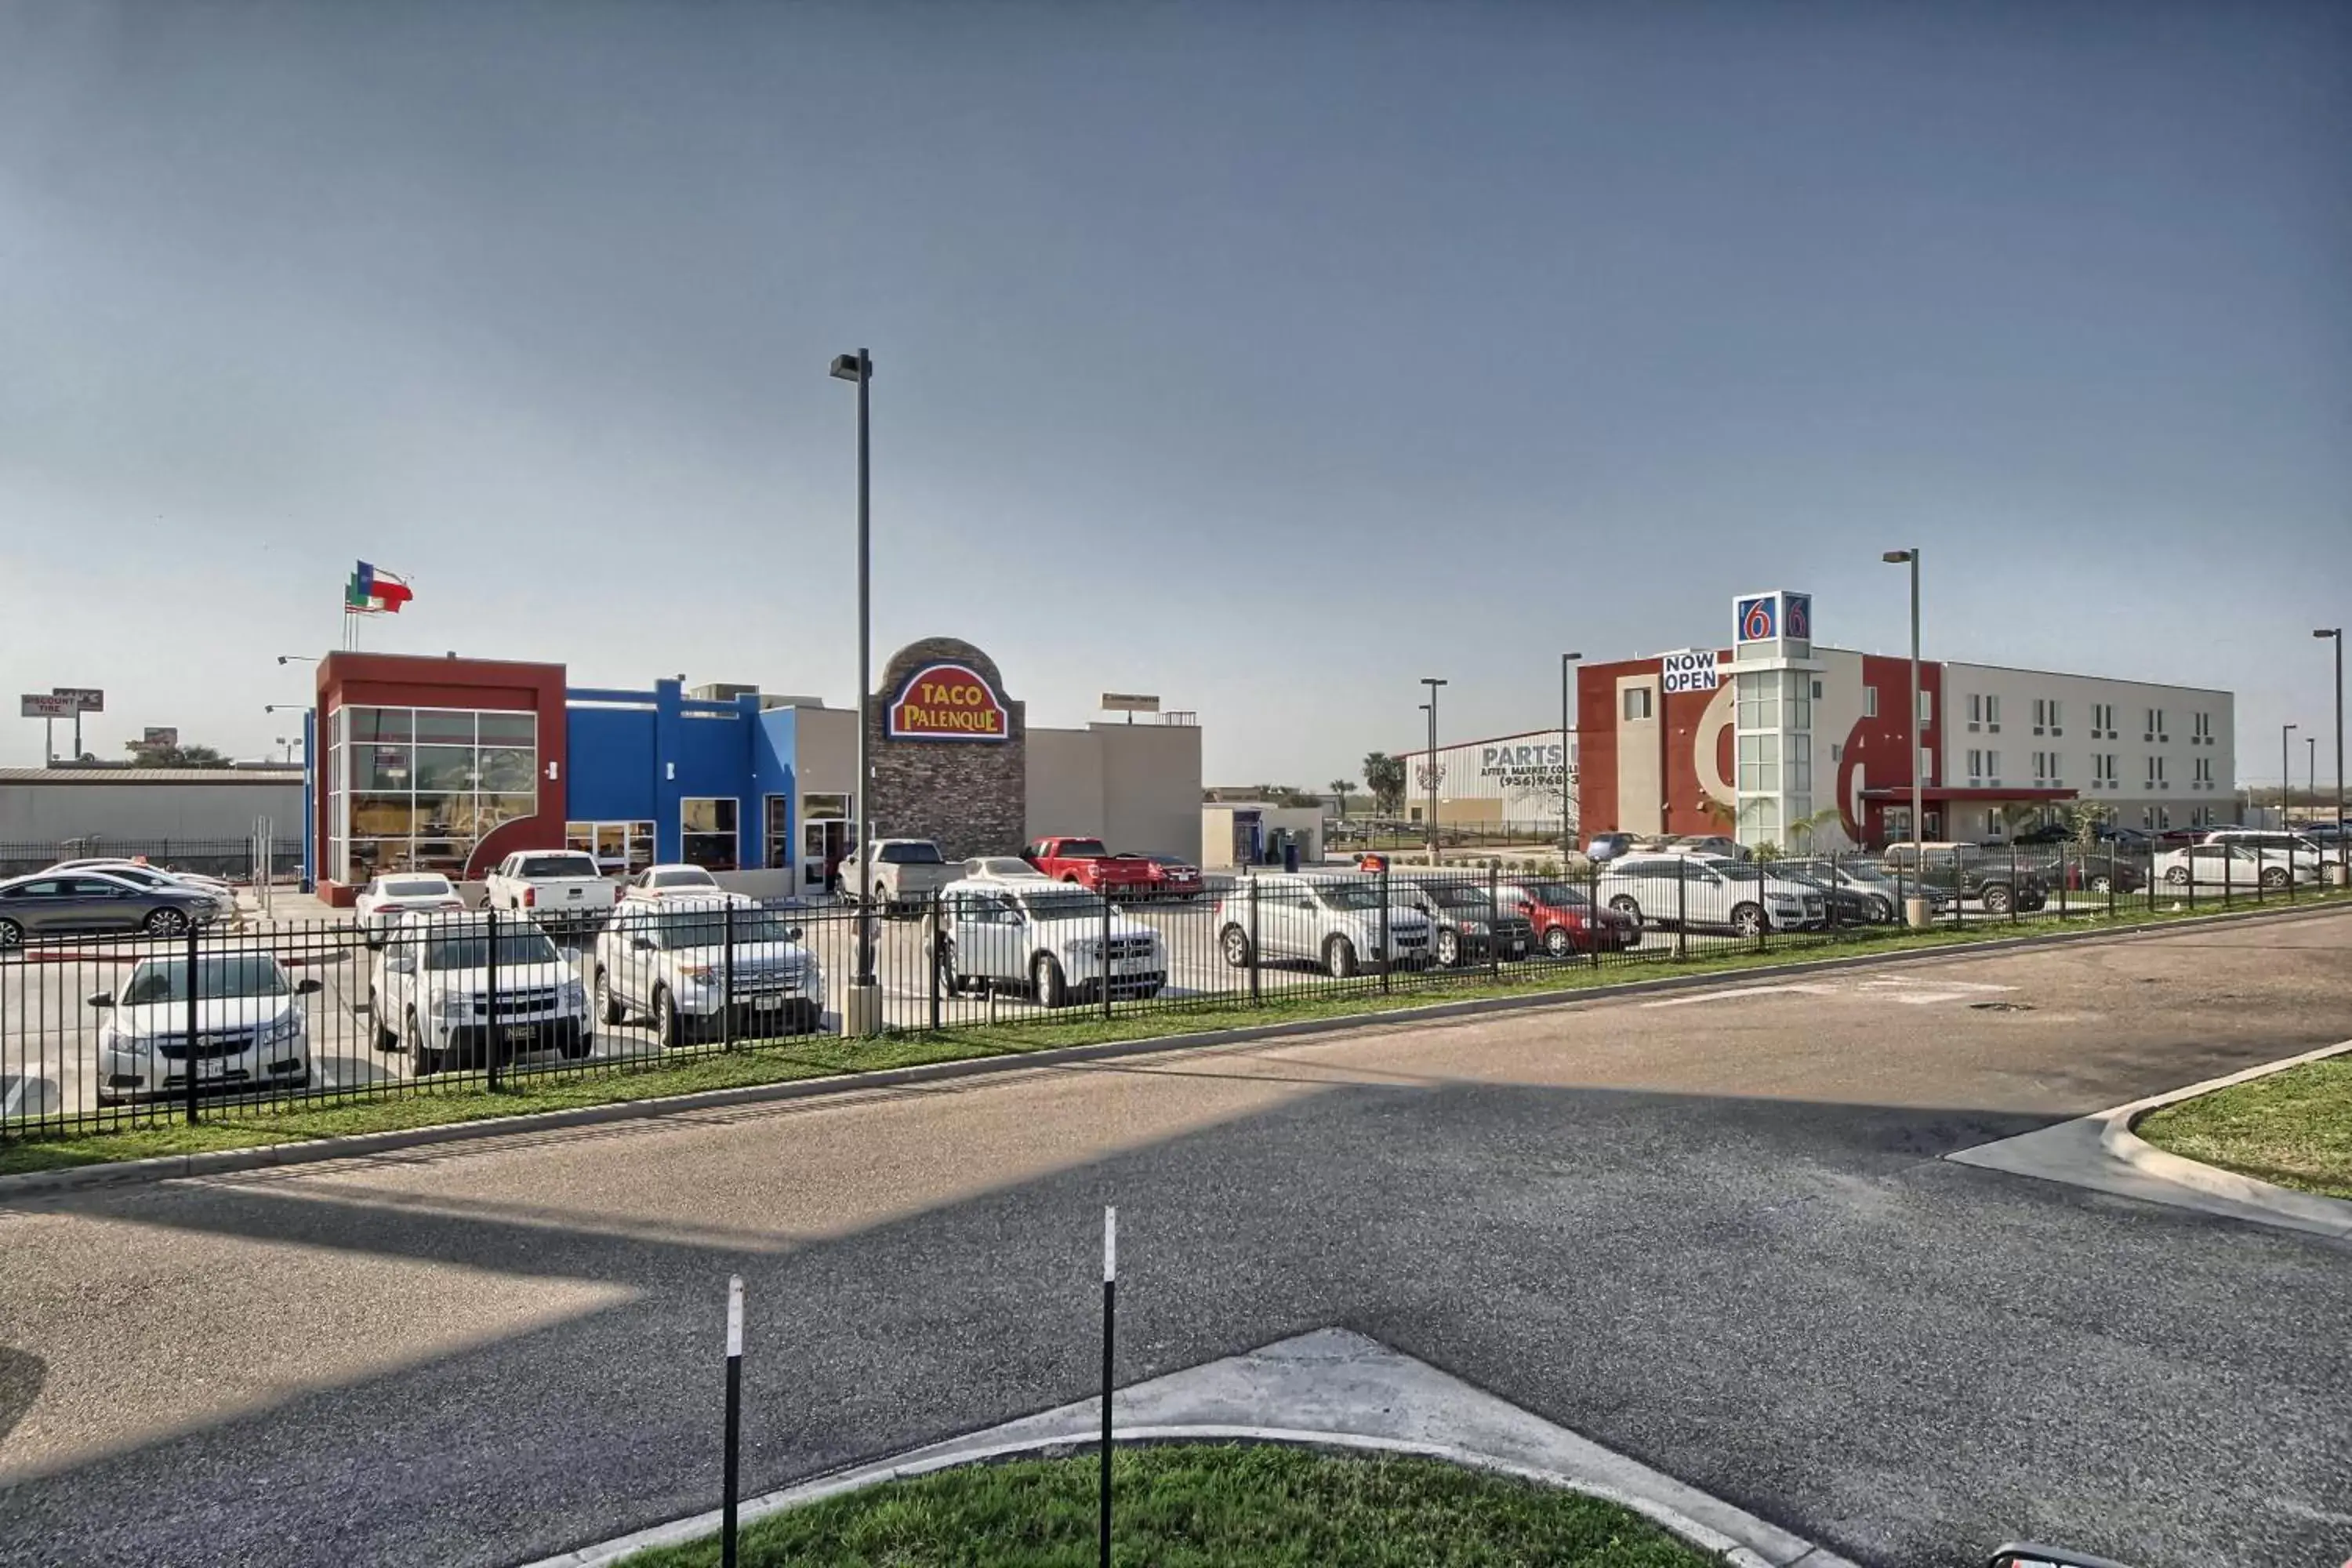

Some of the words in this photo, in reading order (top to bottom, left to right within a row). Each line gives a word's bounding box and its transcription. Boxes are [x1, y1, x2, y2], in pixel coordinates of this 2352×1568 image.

[1744, 600, 1771, 640] 6
[1788, 600, 1806, 637] 6
[1666, 652, 1714, 671] NOW
[1665, 671, 1716, 691] OPEN
[921, 683, 982, 706] TACO
[904, 705, 998, 731] PALENQUE
[1483, 745, 1562, 767] PARTS
[1512, 765, 1548, 775] MARKET
